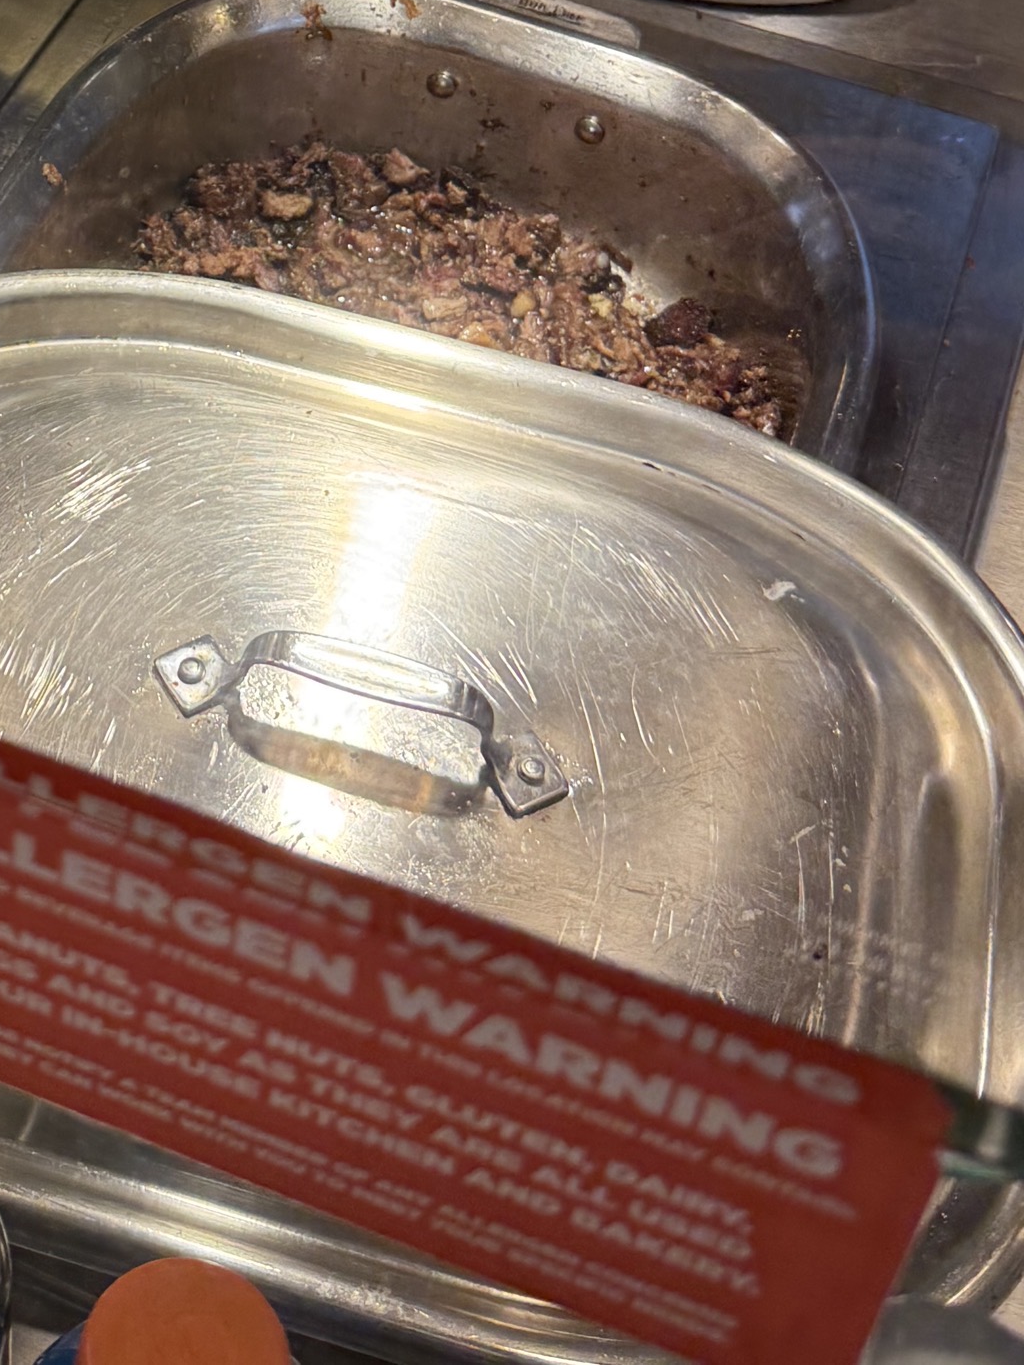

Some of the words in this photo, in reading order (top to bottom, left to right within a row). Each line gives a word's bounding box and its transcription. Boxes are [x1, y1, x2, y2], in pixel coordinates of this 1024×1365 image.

[47, 972, 136, 1019] AND
[143, 1010, 229, 1055] SOY
[238, 1049, 297, 1084] AS
[306, 1072, 422, 1130] THEY
[430, 1124, 523, 1172] ARE
[531, 1166, 619, 1212] ALL
[628, 1199, 752, 1261] USED
[59, 1004, 261, 1100] IN-HOUSE
[267, 1088, 455, 1175] KITCHEN
[462, 1167, 564, 1216] AND
[570, 1205, 761, 1297] BAKERY.
[147, 980, 258, 1040] TREE
[264, 1028, 396, 1098] NUTS,
[404, 1084, 596, 1175] GLUTEN,
[604, 1160, 755, 1236] DAIRY,
[379, 970, 842, 1179] WARNING
